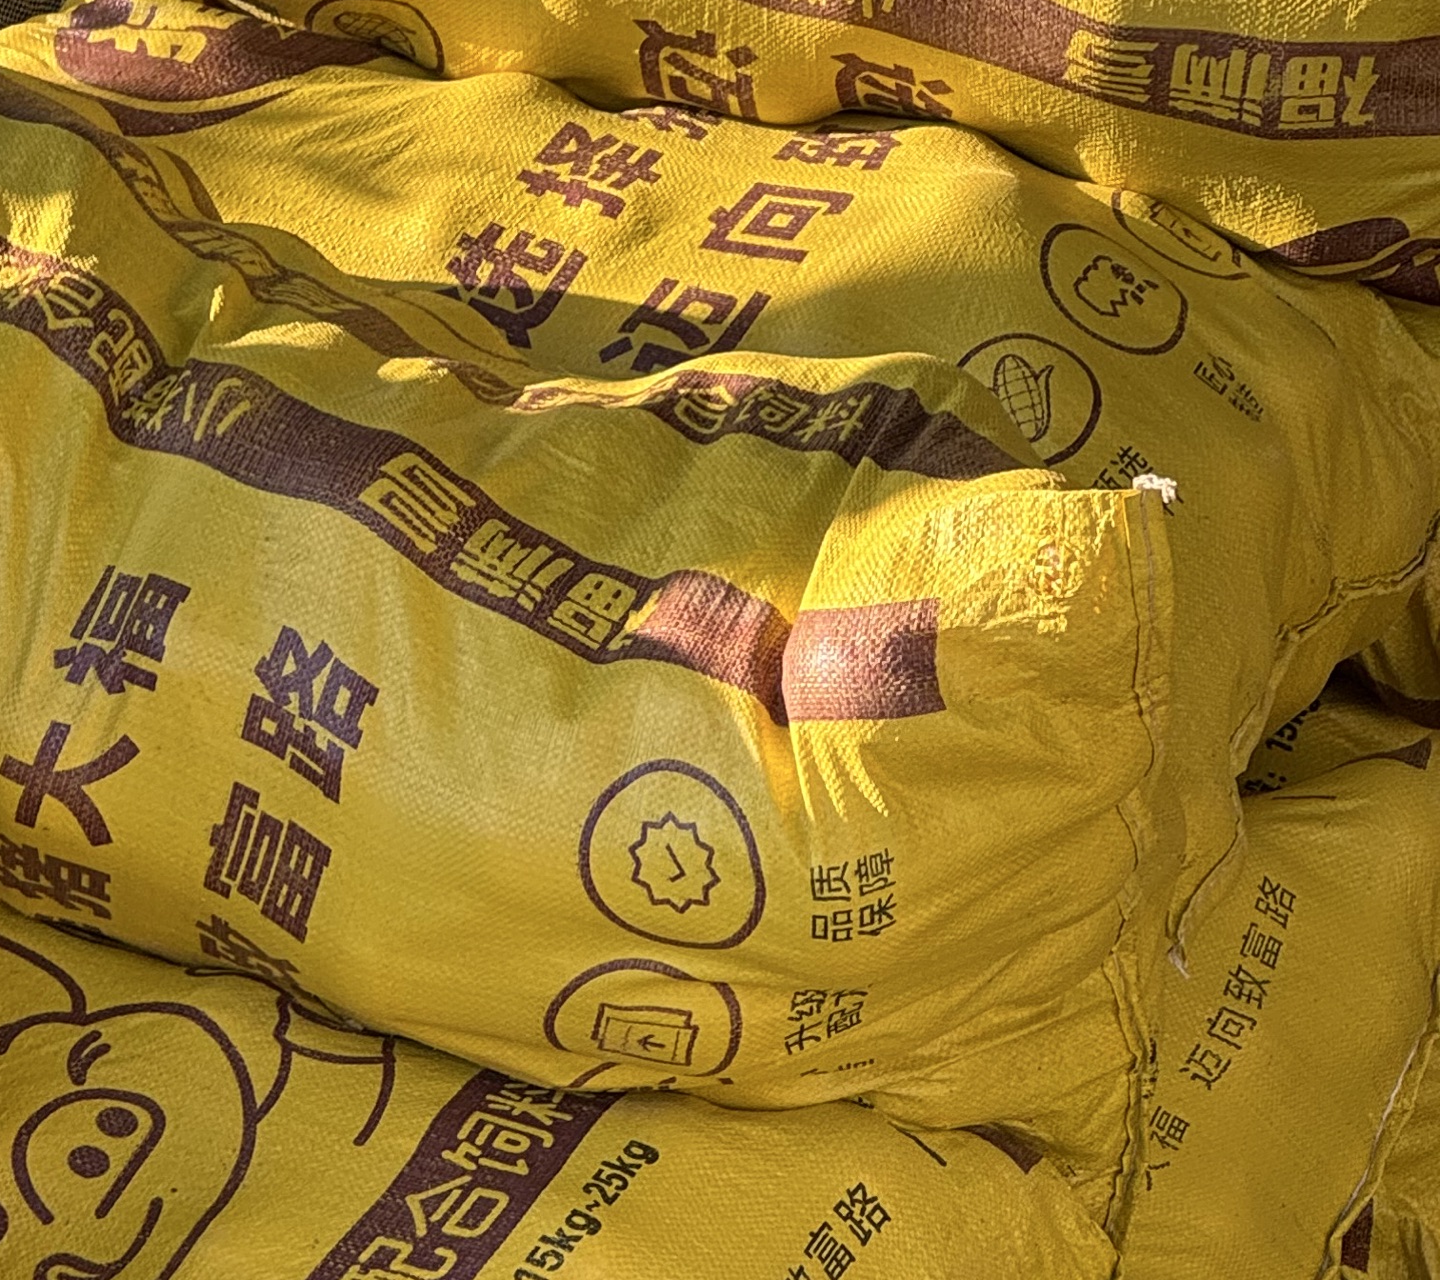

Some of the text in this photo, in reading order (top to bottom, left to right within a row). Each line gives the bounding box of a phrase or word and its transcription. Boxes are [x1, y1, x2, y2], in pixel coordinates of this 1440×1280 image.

[1063, 29, 1382, 130] 福满多
[359, 452, 661, 652] 福满多
[808, 859, 853, 944] 品质
[850, 846, 898, 939] 保障
[1179, 873, 1301, 1094] 迈向致富路
